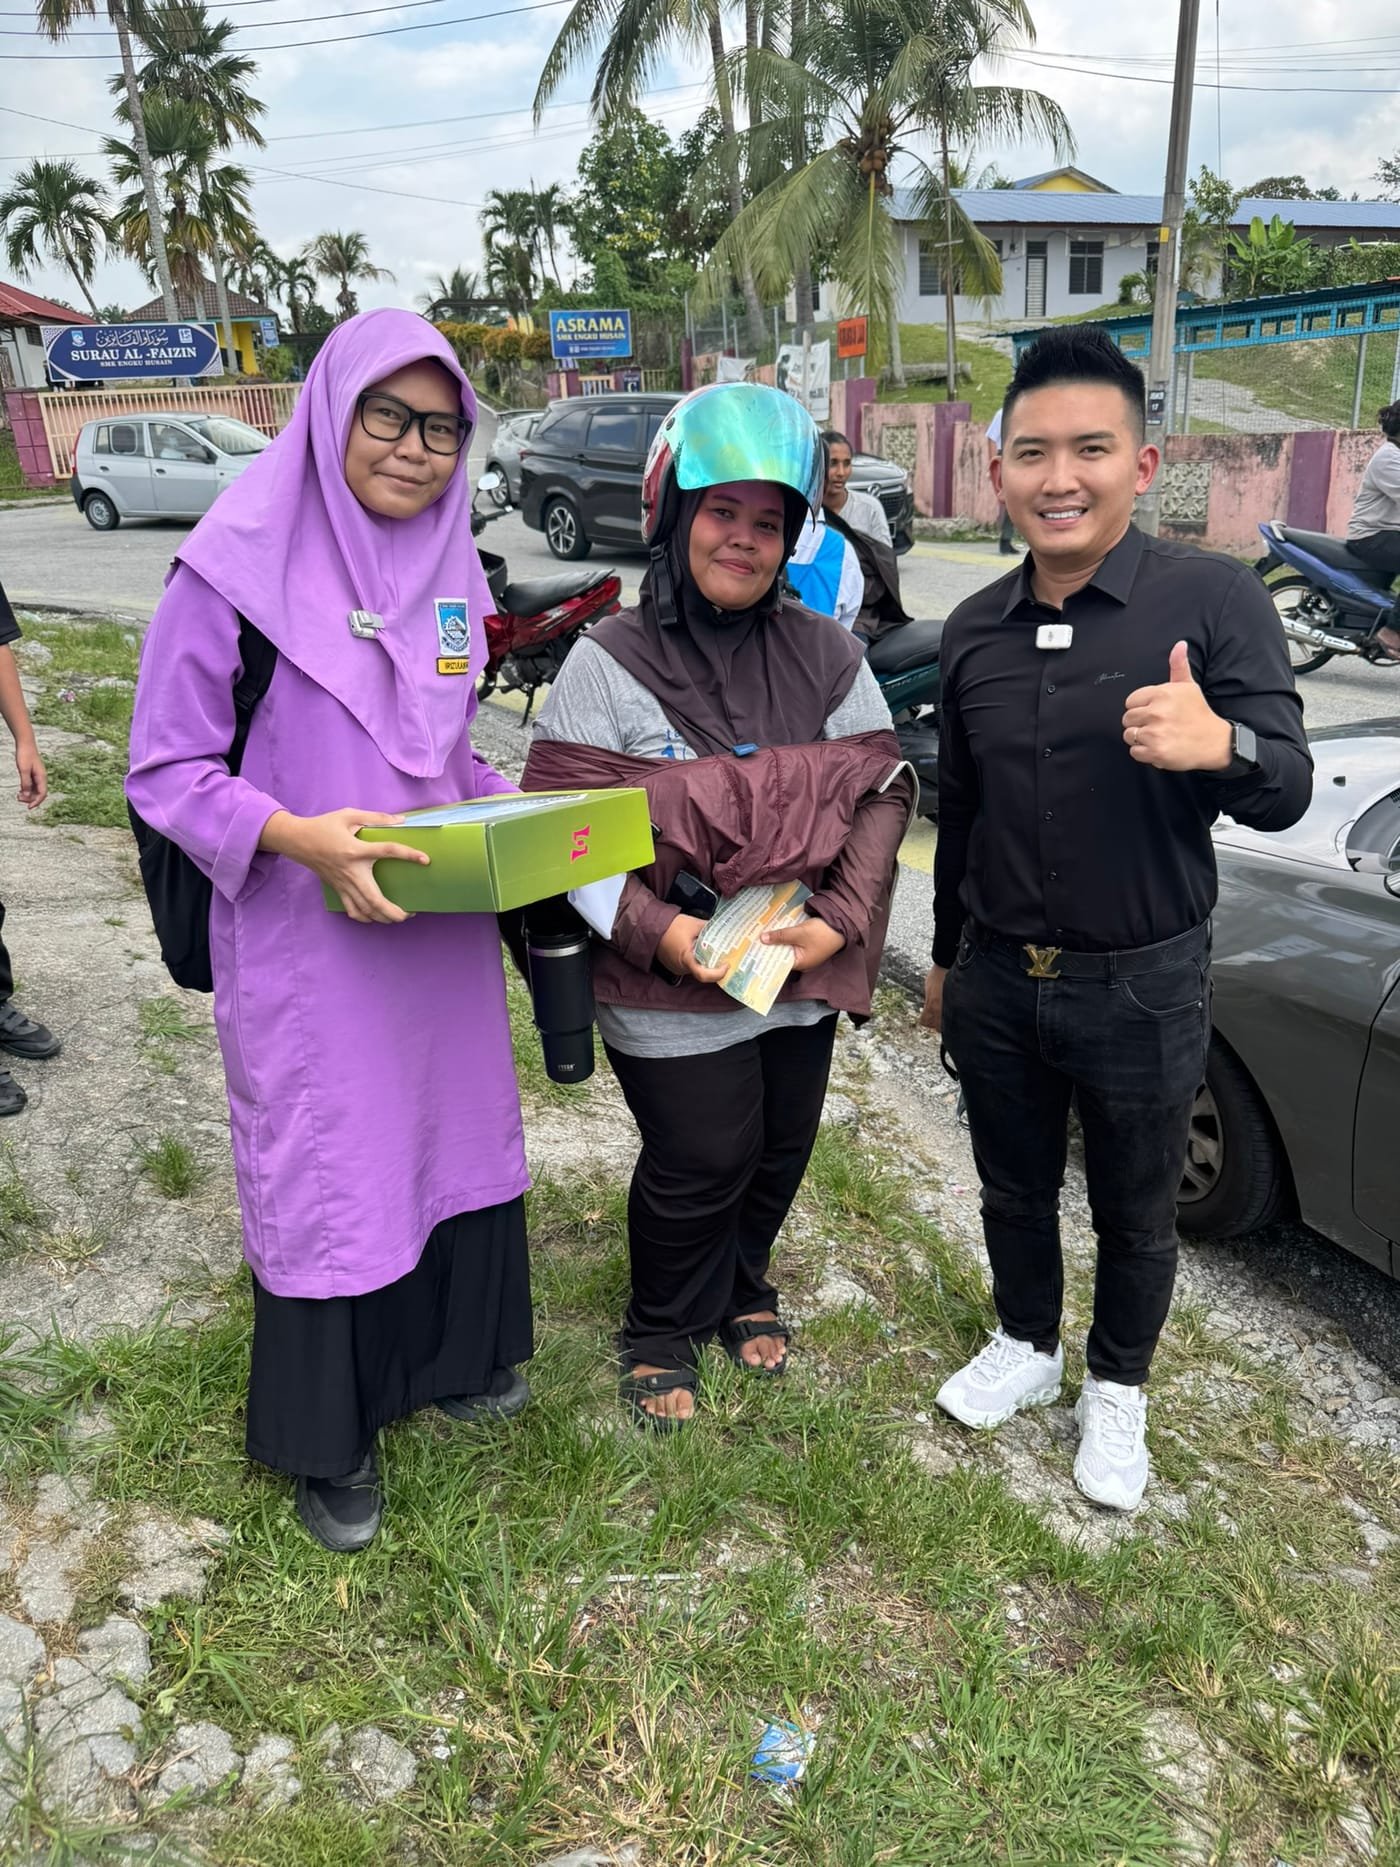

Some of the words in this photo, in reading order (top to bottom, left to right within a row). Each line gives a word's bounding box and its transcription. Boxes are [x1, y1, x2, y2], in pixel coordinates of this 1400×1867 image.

[556, 317, 625, 332] ASRAMA
[71, 348, 119, 361] SURAU
[124, 348, 143, 360] AL
